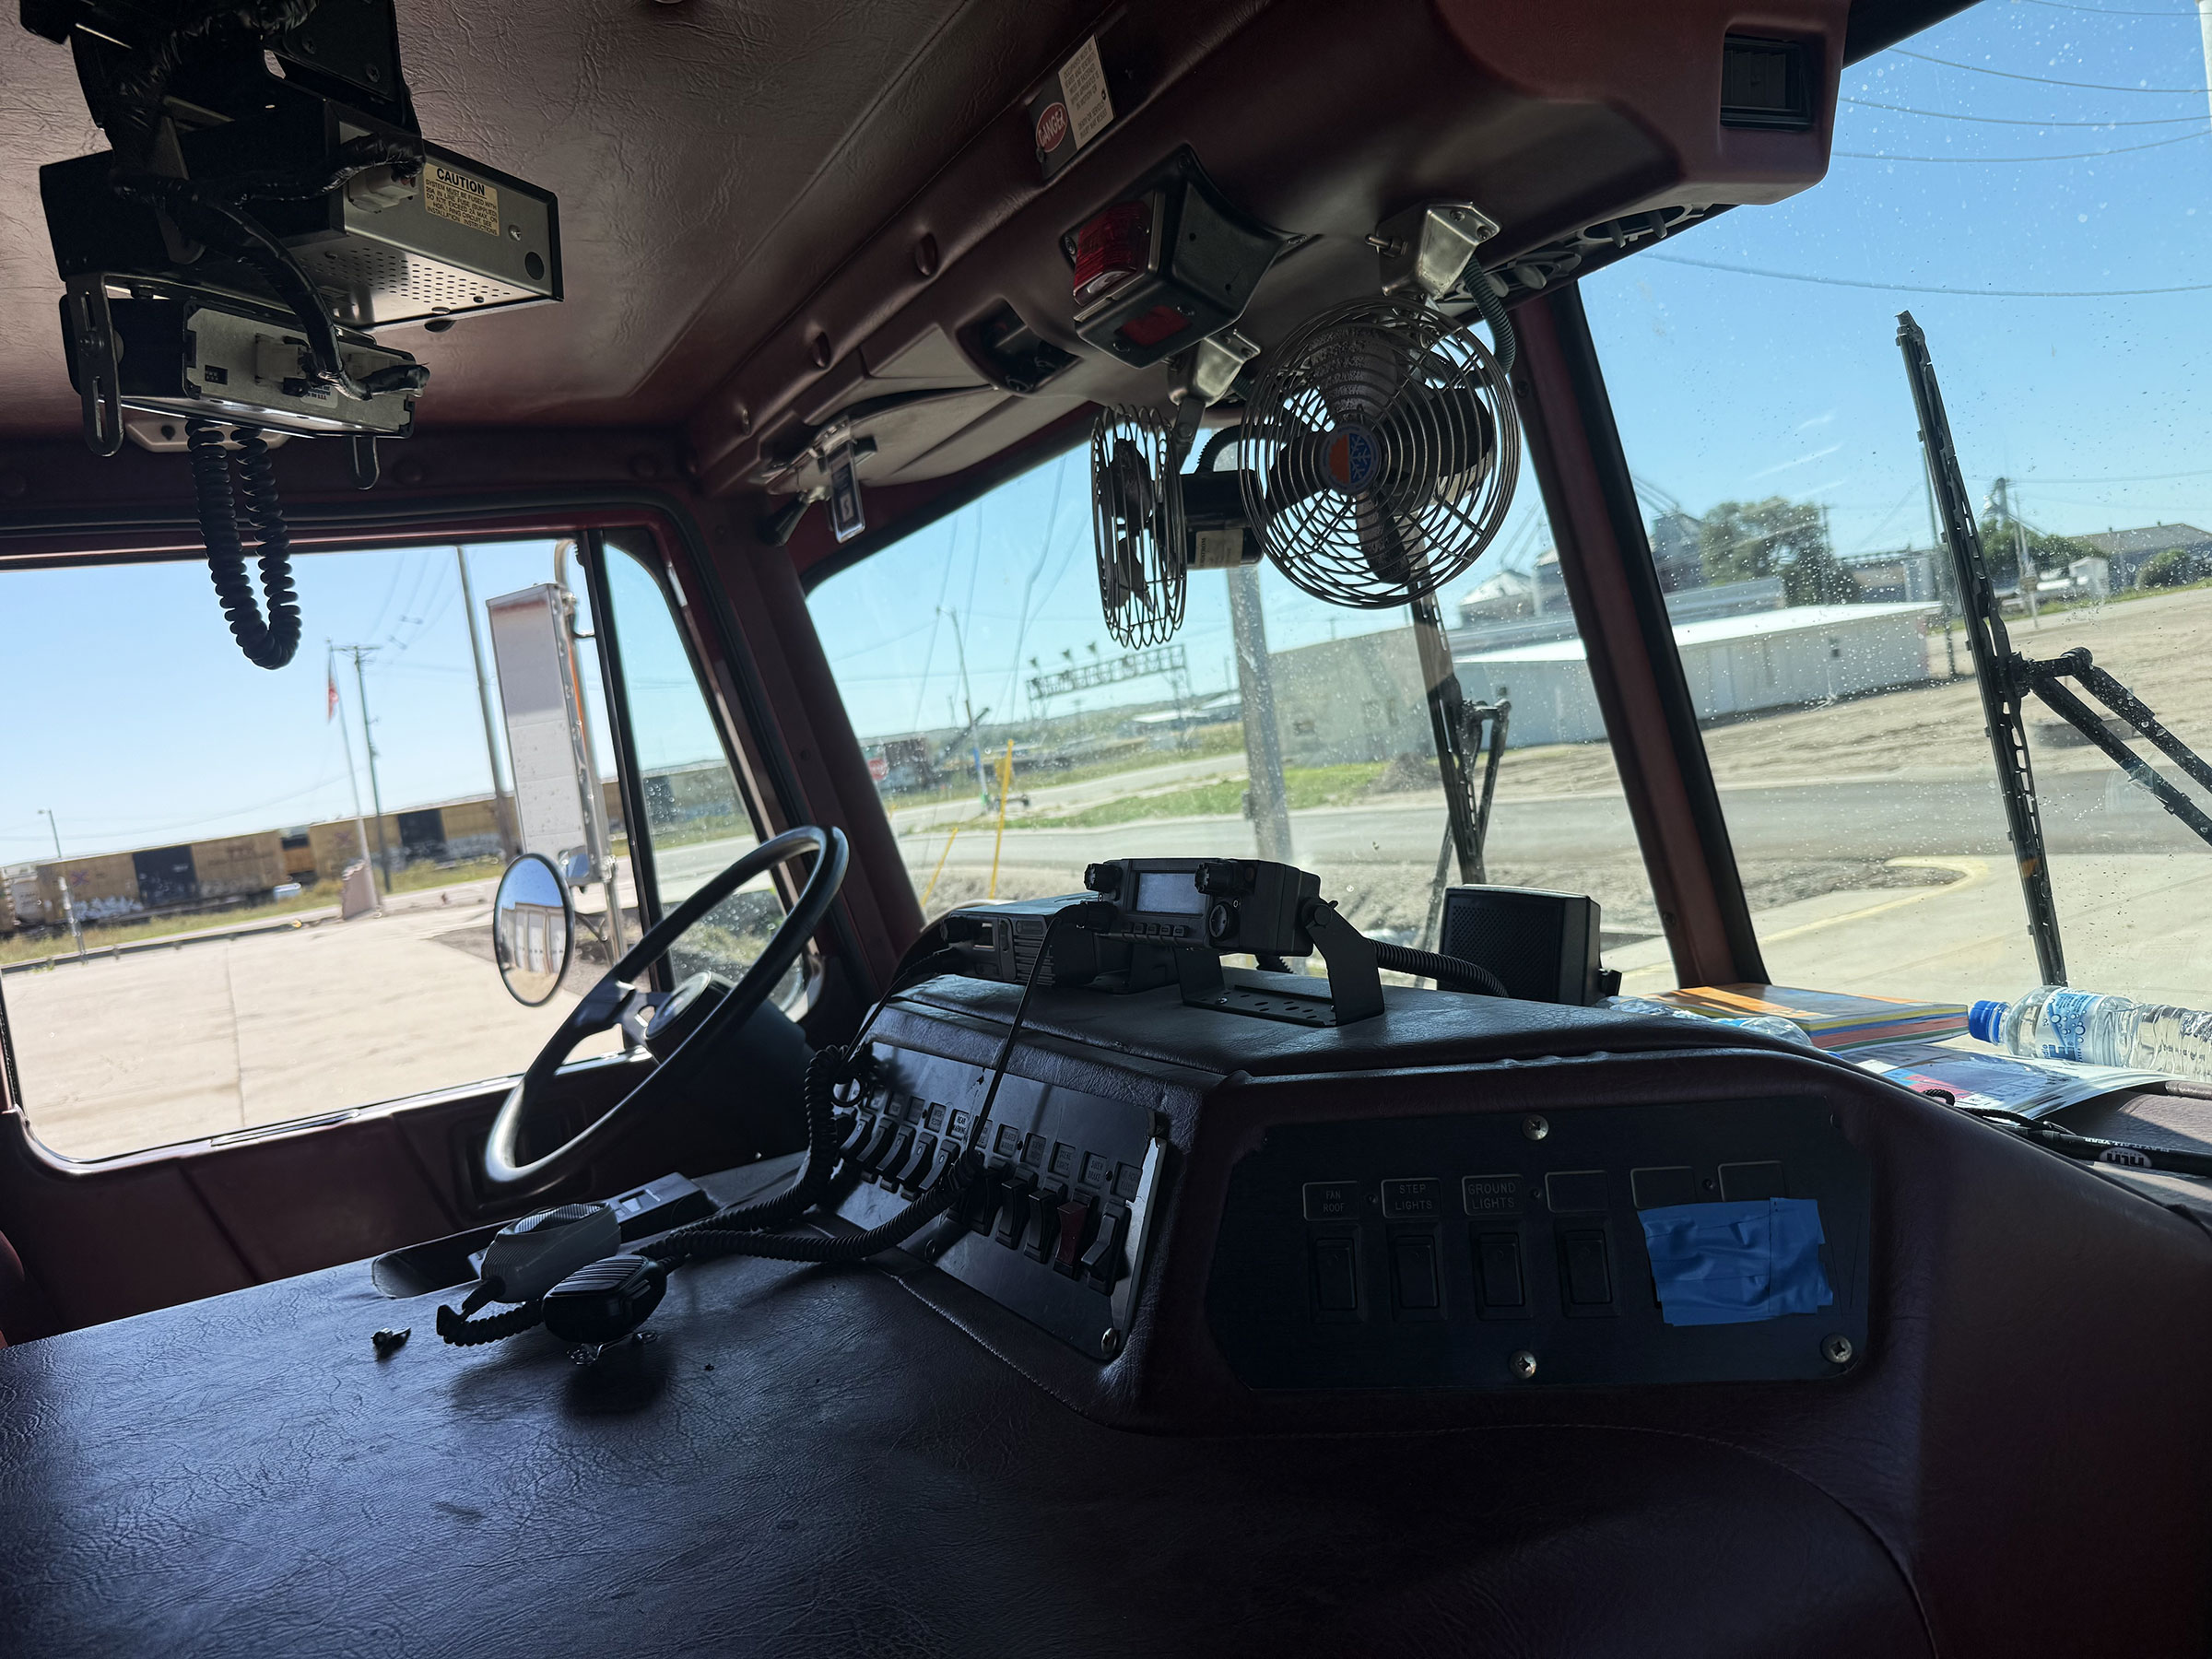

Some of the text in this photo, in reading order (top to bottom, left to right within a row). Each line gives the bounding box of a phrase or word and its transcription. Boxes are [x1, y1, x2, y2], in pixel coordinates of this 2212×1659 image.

[1038, 108, 1066, 147] DANGER
[437, 169, 485, 195] CAUTION
[426, 180, 445, 191] SYSTEM
[446, 186, 459, 196] MUST
[468, 194, 484, 206] FUSED
[485, 201, 496, 210] WITH
[444, 194, 455, 202] LINE
[458, 198, 470, 207] FUSE
[449, 200, 467, 212] EXCEED
[450, 207, 461, 216] RING
[483, 219, 491, 228] SEE
[1325, 1190, 1341, 1199] FAN
[1399, 1184, 1427, 1194] STEP
[1467, 1181, 1516, 1195] GROUND
[1323, 1203, 1345, 1213] ROOF
[1395, 1200, 1432, 1210] LIGHTS
[1471, 1195, 1515, 1210] LIGHTS
